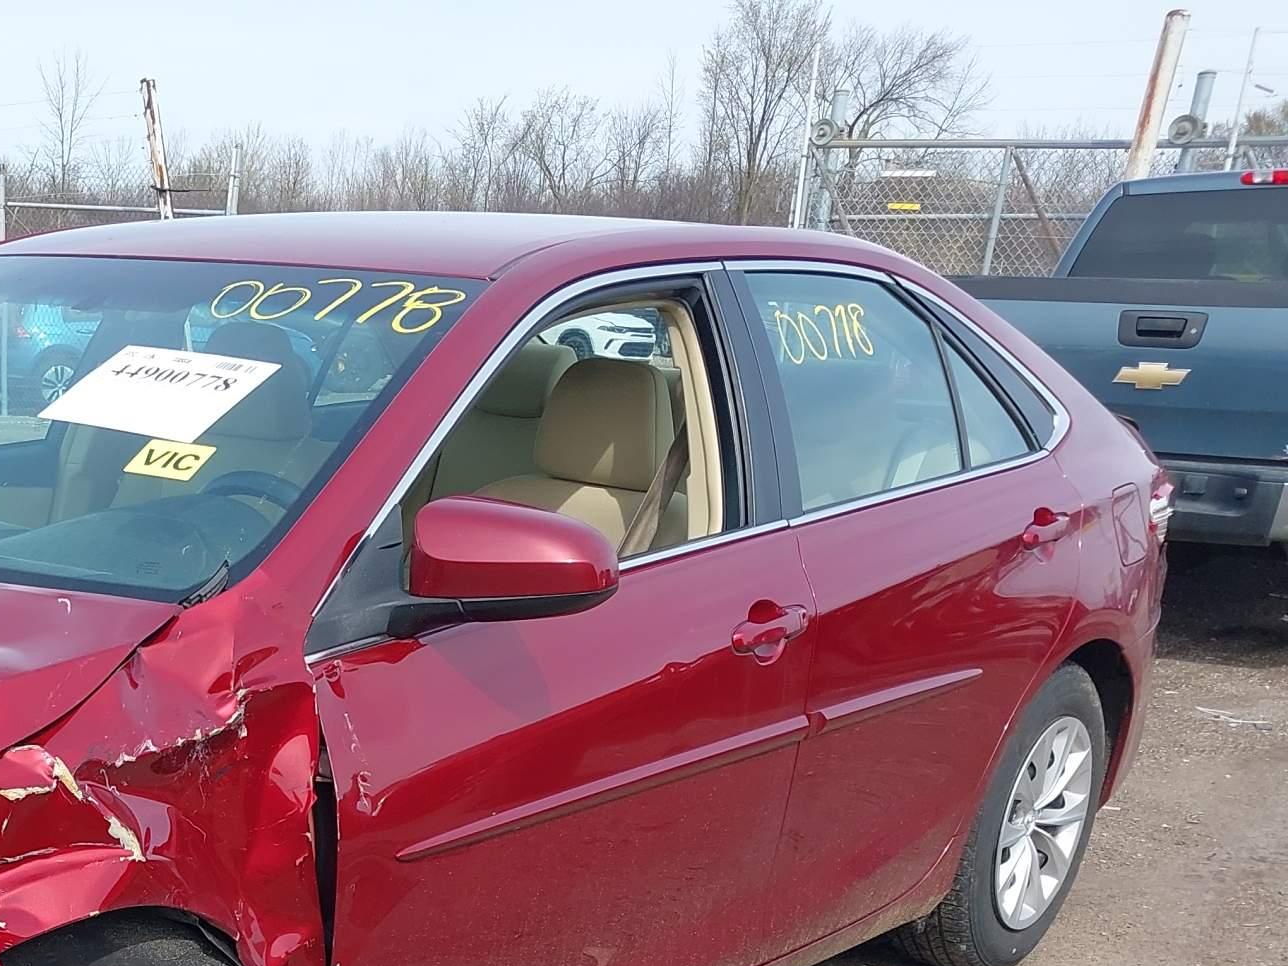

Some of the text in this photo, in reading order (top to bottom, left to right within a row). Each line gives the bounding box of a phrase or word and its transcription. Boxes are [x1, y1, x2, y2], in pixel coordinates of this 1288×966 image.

[210, 278, 466, 334] 00778
[774, 303, 874, 365] 00778
[111, 363, 238, 392] 44900778
[142, 447, 202, 472] VIC
